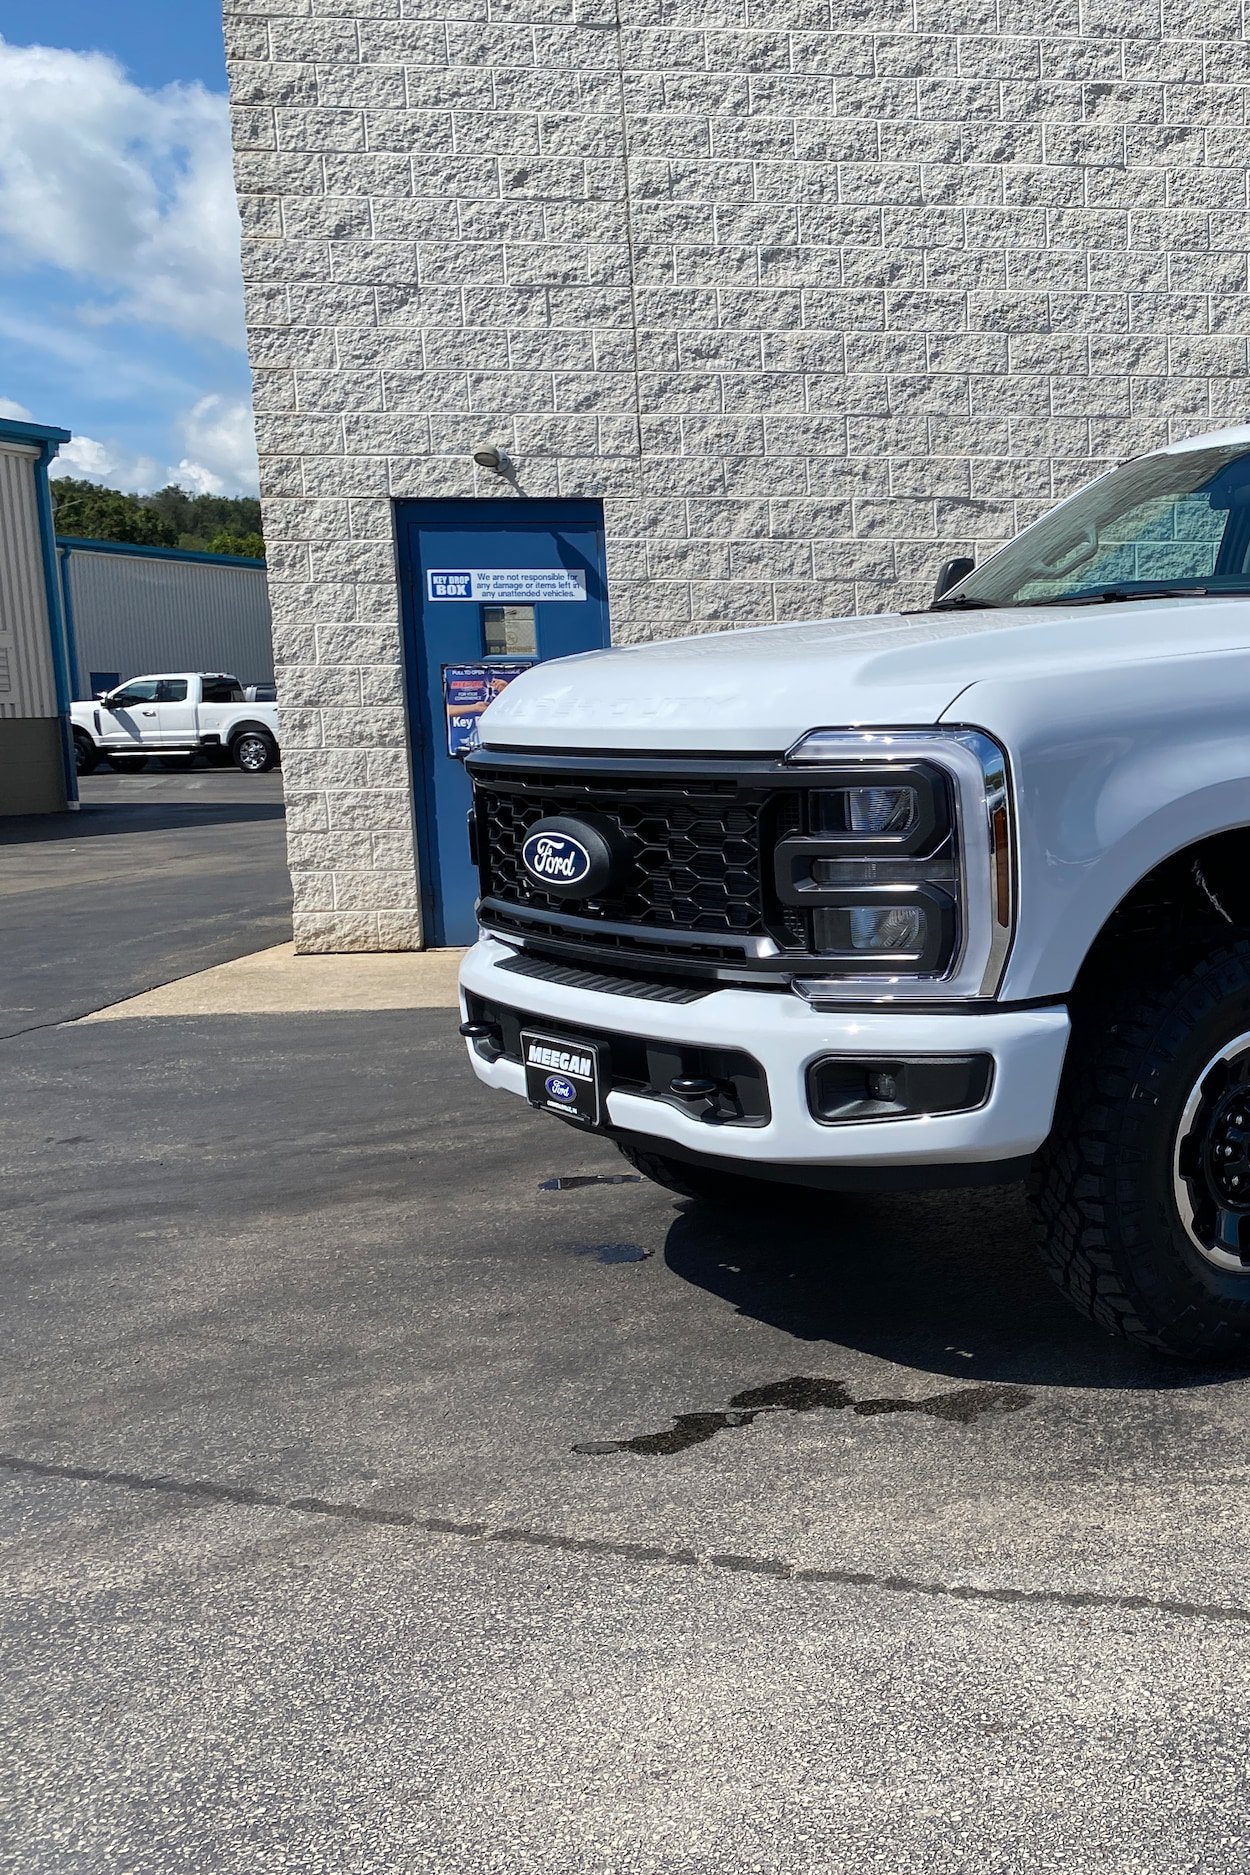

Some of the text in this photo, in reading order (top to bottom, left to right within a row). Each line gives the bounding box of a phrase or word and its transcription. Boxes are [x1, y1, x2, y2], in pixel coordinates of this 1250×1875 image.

[432, 575, 470, 585] KEY DROP
[477, 573, 490, 581] We
[506, 573, 519, 581] not
[520, 573, 565, 583] responsible
[567, 573, 578, 581] for
[436, 585, 467, 596] BOX
[476, 582, 490, 590] any
[493, 581, 524, 590] damage
[535, 581, 557, 589] items
[558, 581, 571, 589] left
[481, 589, 576, 598] any unattended vehicles.
[452, 716, 473, 730] Key
[534, 838, 576, 877] Ford
[528, 1044, 592, 1077] MEEGAN
[551, 1079, 570, 1097] Ford
